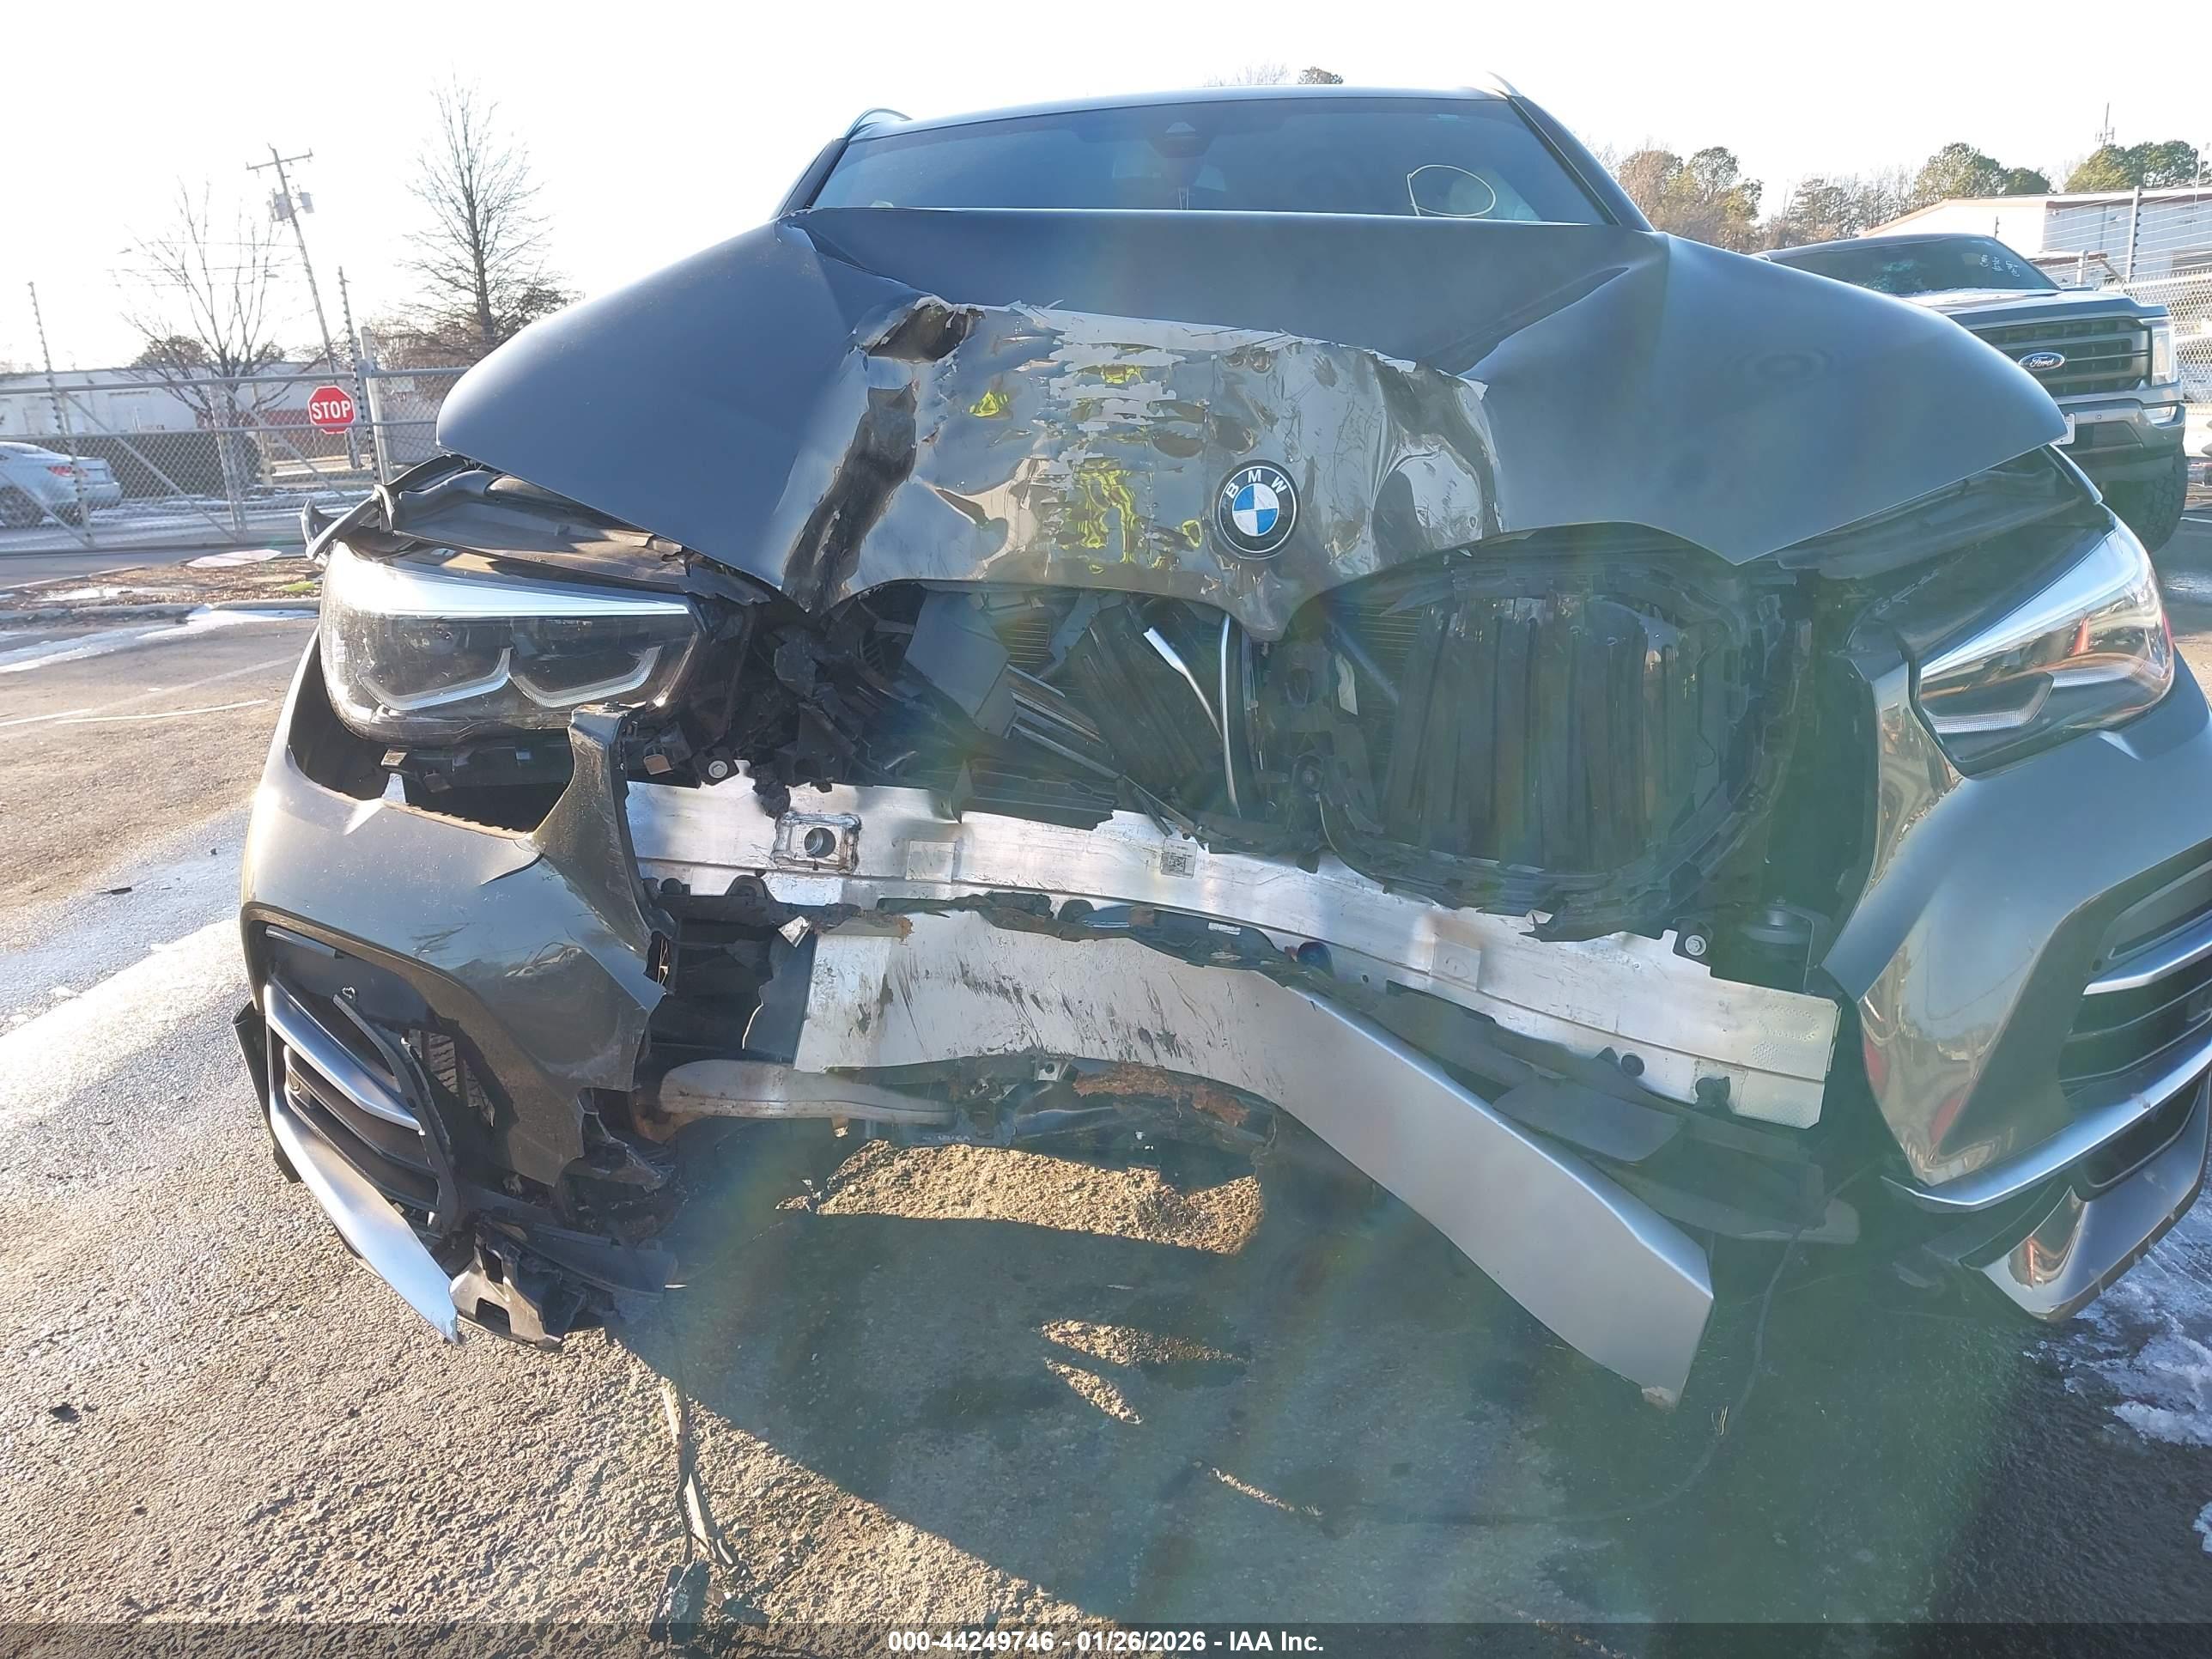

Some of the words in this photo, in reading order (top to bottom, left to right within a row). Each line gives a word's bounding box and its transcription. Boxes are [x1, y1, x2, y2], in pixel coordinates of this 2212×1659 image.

[2029, 356, 2055, 368] Ford
[311, 399, 351, 420] STOP
[1225, 469, 1288, 499] BMW
